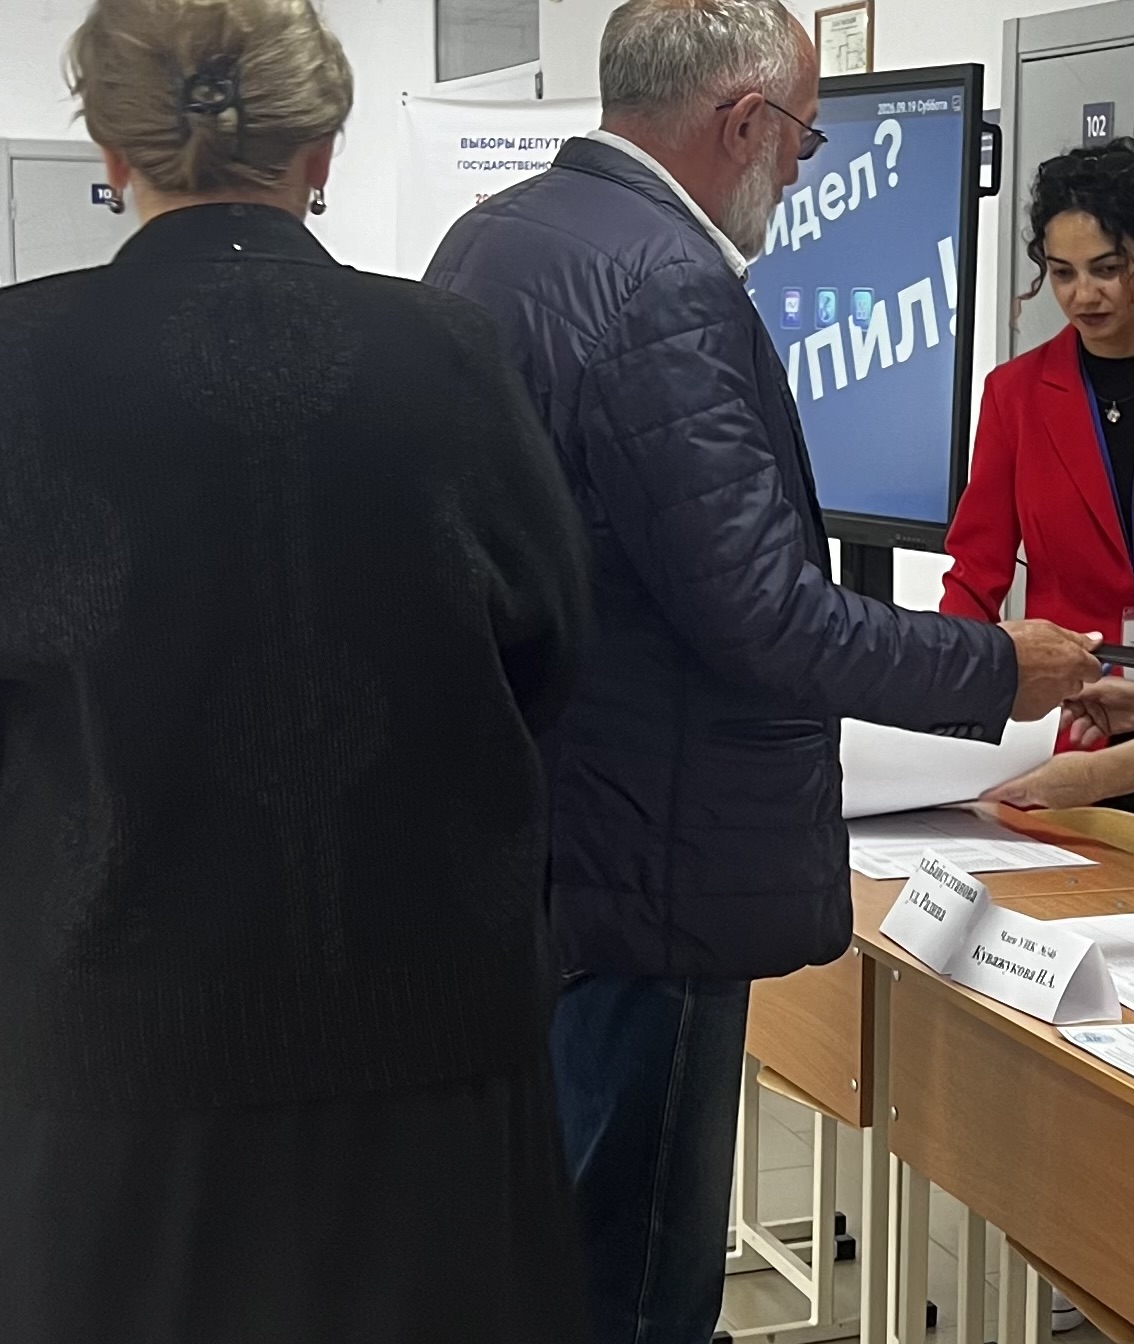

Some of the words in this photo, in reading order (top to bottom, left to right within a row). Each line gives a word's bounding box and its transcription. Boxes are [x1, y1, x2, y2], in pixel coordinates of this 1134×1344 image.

[1087, 114, 1107, 137] 102
[460, 137, 515, 149] ВЫБОРЫ
[457, 160, 552, 171] ГОСУДАРСТВЕННО
[98, 188, 113, 199] 10
[765, 119, 902, 255] идел?
[748, 236, 957, 406] пил!
[1035, 968, 1056, 989] Н.А.
